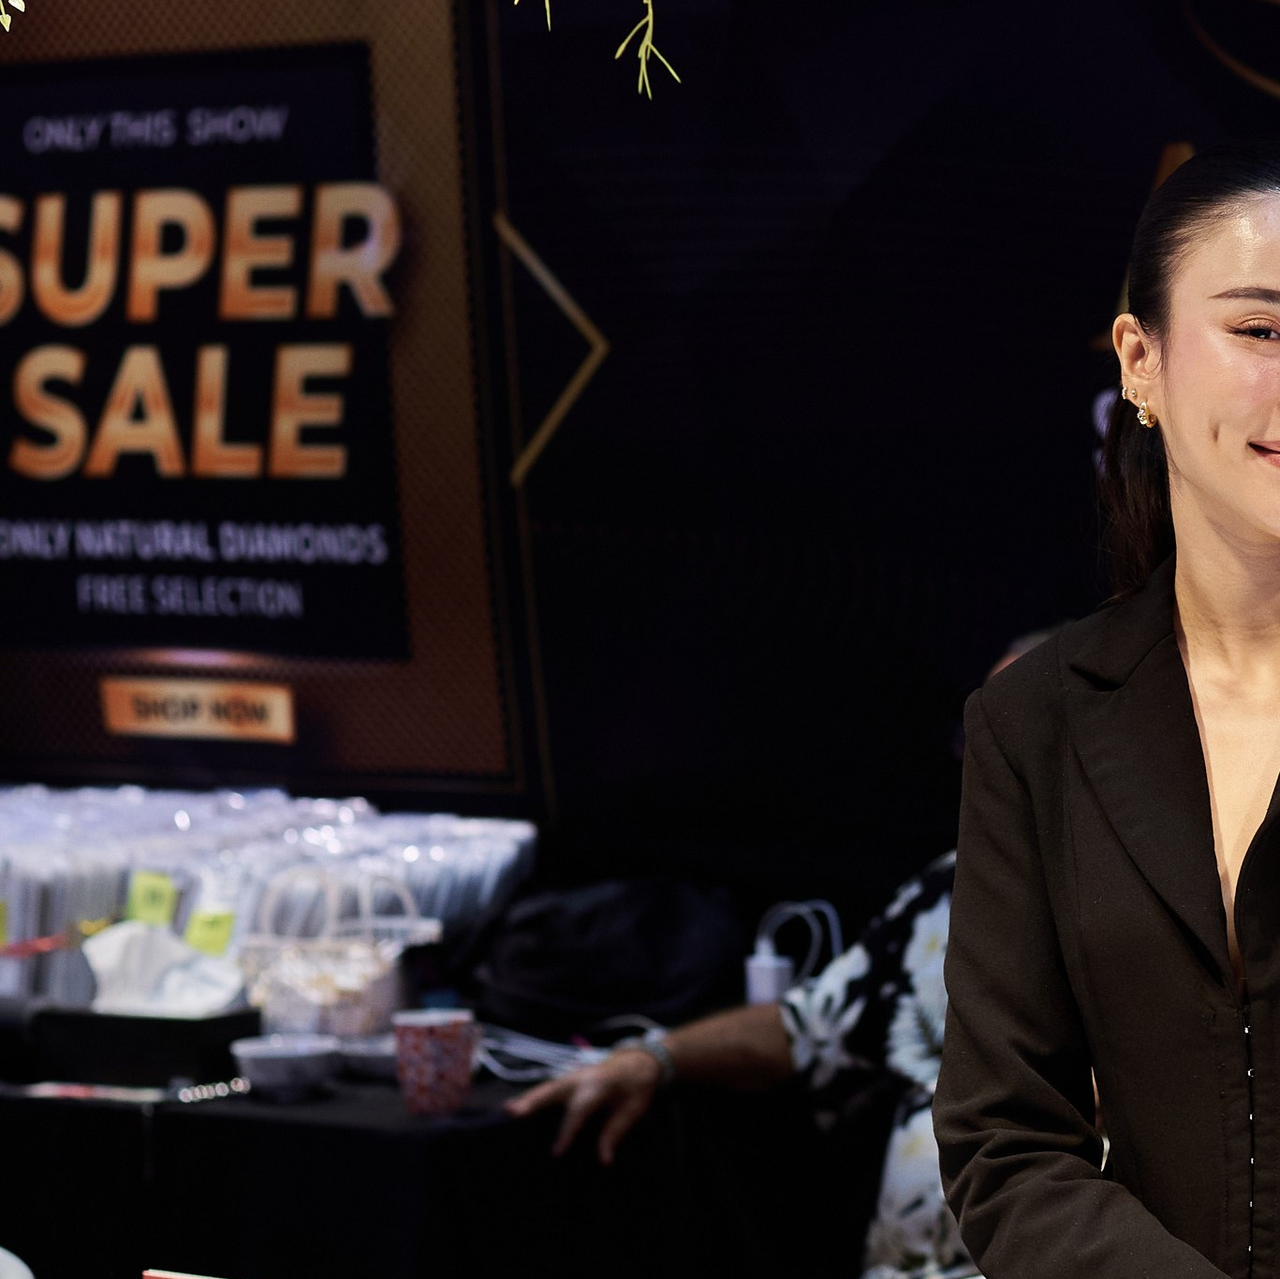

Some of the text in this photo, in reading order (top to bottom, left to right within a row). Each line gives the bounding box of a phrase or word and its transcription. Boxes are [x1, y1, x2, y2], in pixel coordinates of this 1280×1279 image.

[22, 101, 291, 155] ONLY THIS SHOW
[6, 341, 356, 481] SALE
